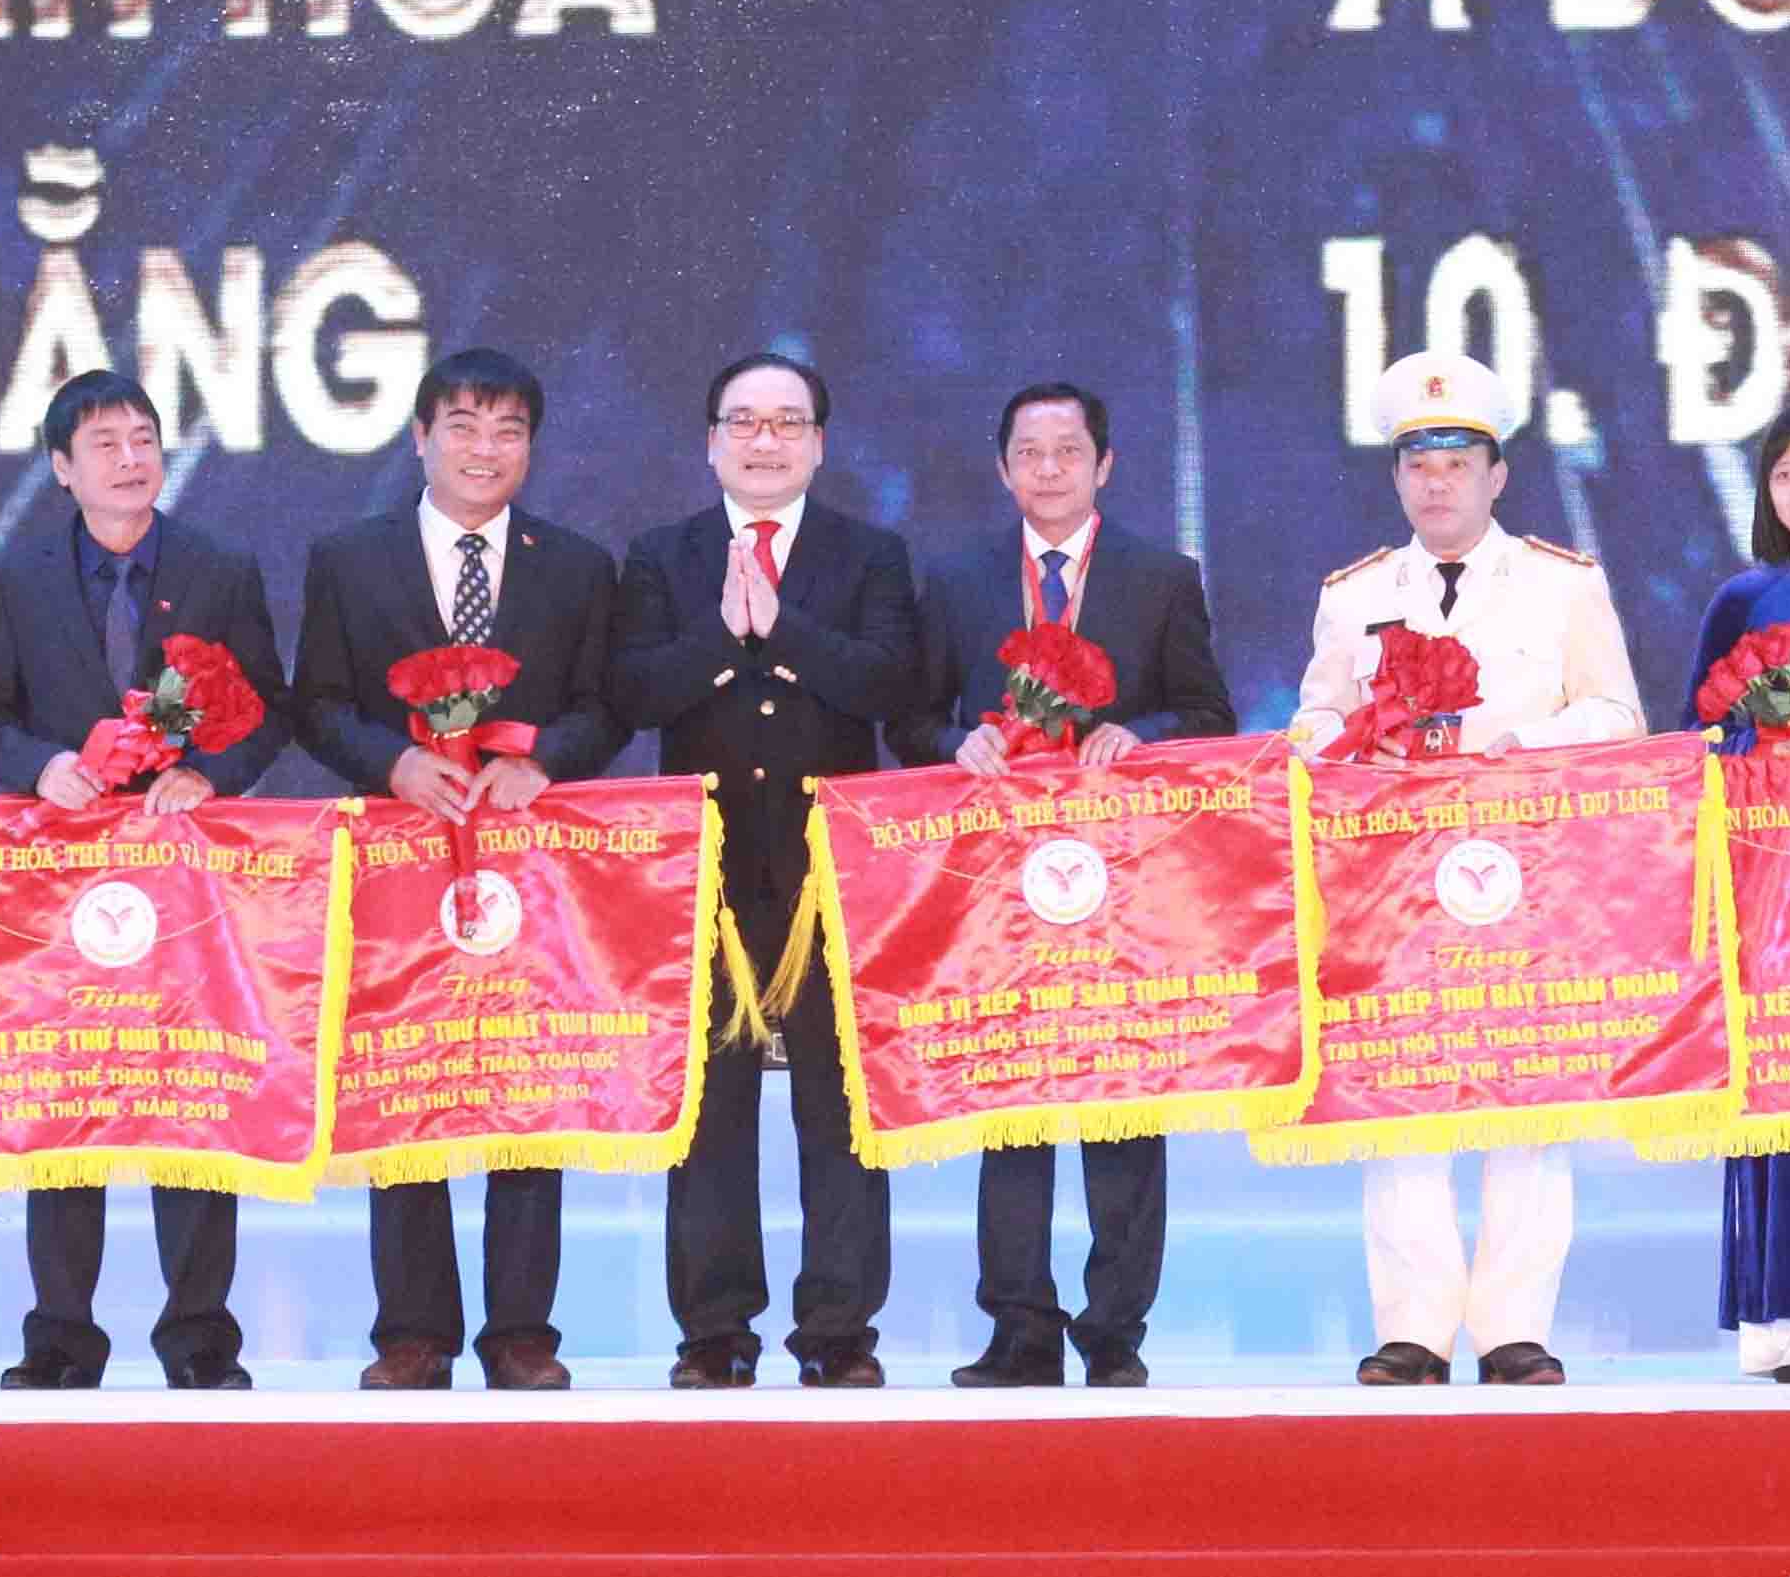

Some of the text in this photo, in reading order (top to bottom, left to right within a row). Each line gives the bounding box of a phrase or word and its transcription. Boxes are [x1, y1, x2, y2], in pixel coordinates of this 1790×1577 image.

[1320, 232, 1590, 447] 10.
[476, 830, 531, 853] THAO
[570, 830, 599, 851] DU
